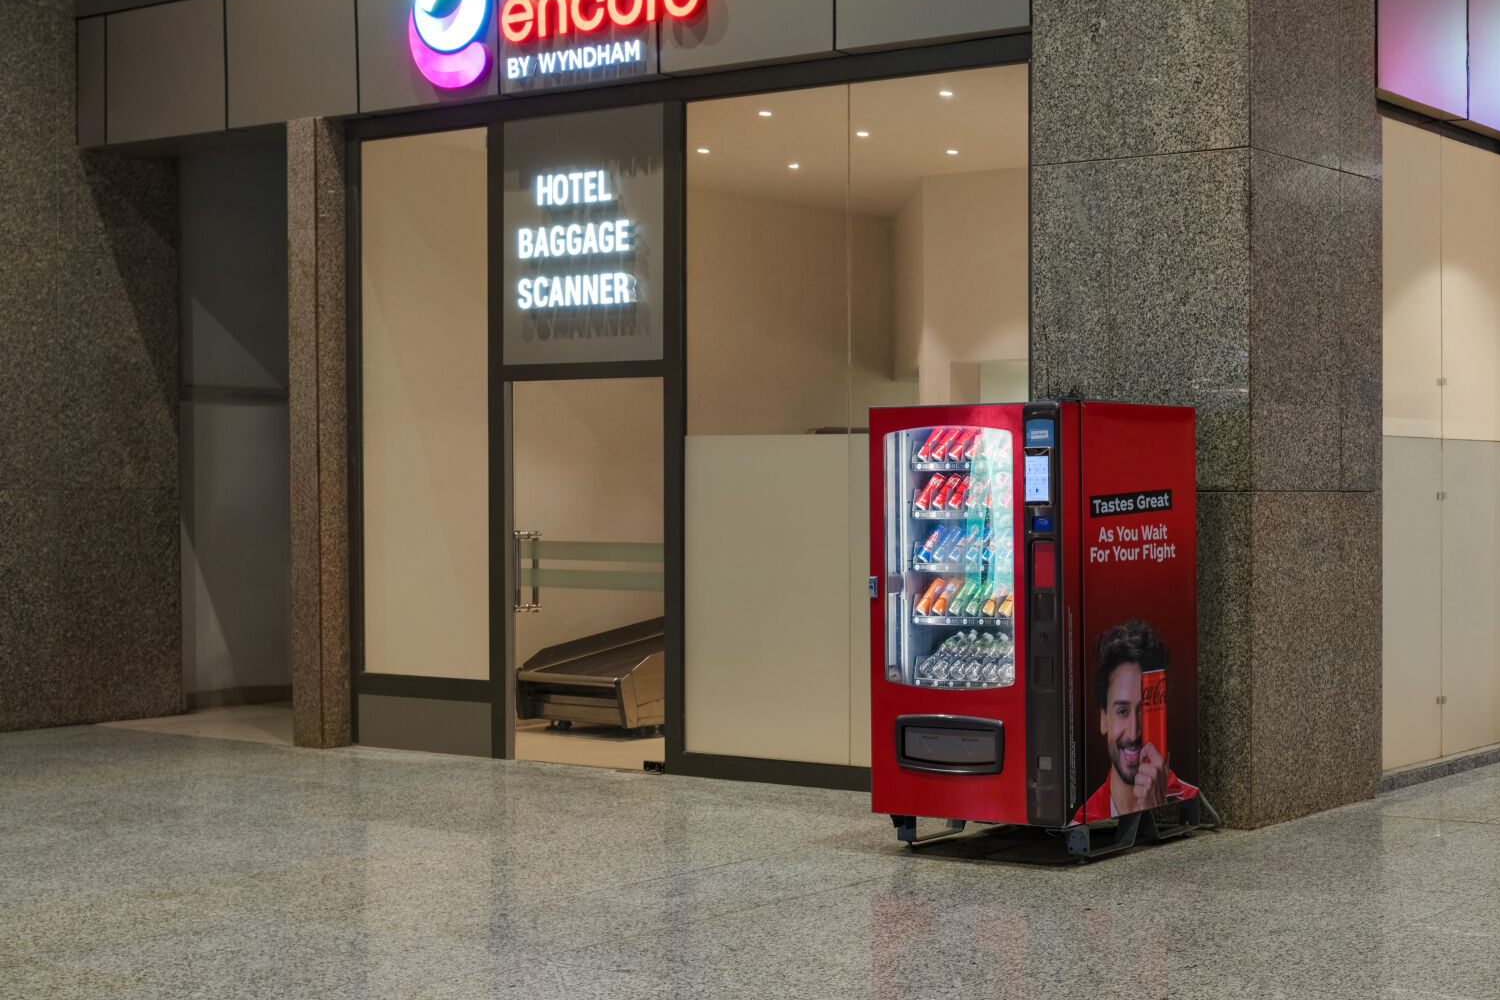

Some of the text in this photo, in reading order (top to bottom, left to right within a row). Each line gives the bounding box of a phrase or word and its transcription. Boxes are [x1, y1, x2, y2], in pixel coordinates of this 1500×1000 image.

[507, 39, 641, 79] BY WYNDHAM
[536, 169, 612, 206] HOTEL
[518, 219, 630, 259] BAGGAGE
[518, 272, 630, 310] SCANNER
[1093, 493, 1169, 514] Tastes Great
[1099, 523, 1168, 542] As You Wait
[1090, 543, 1176, 563] For Your Flight
